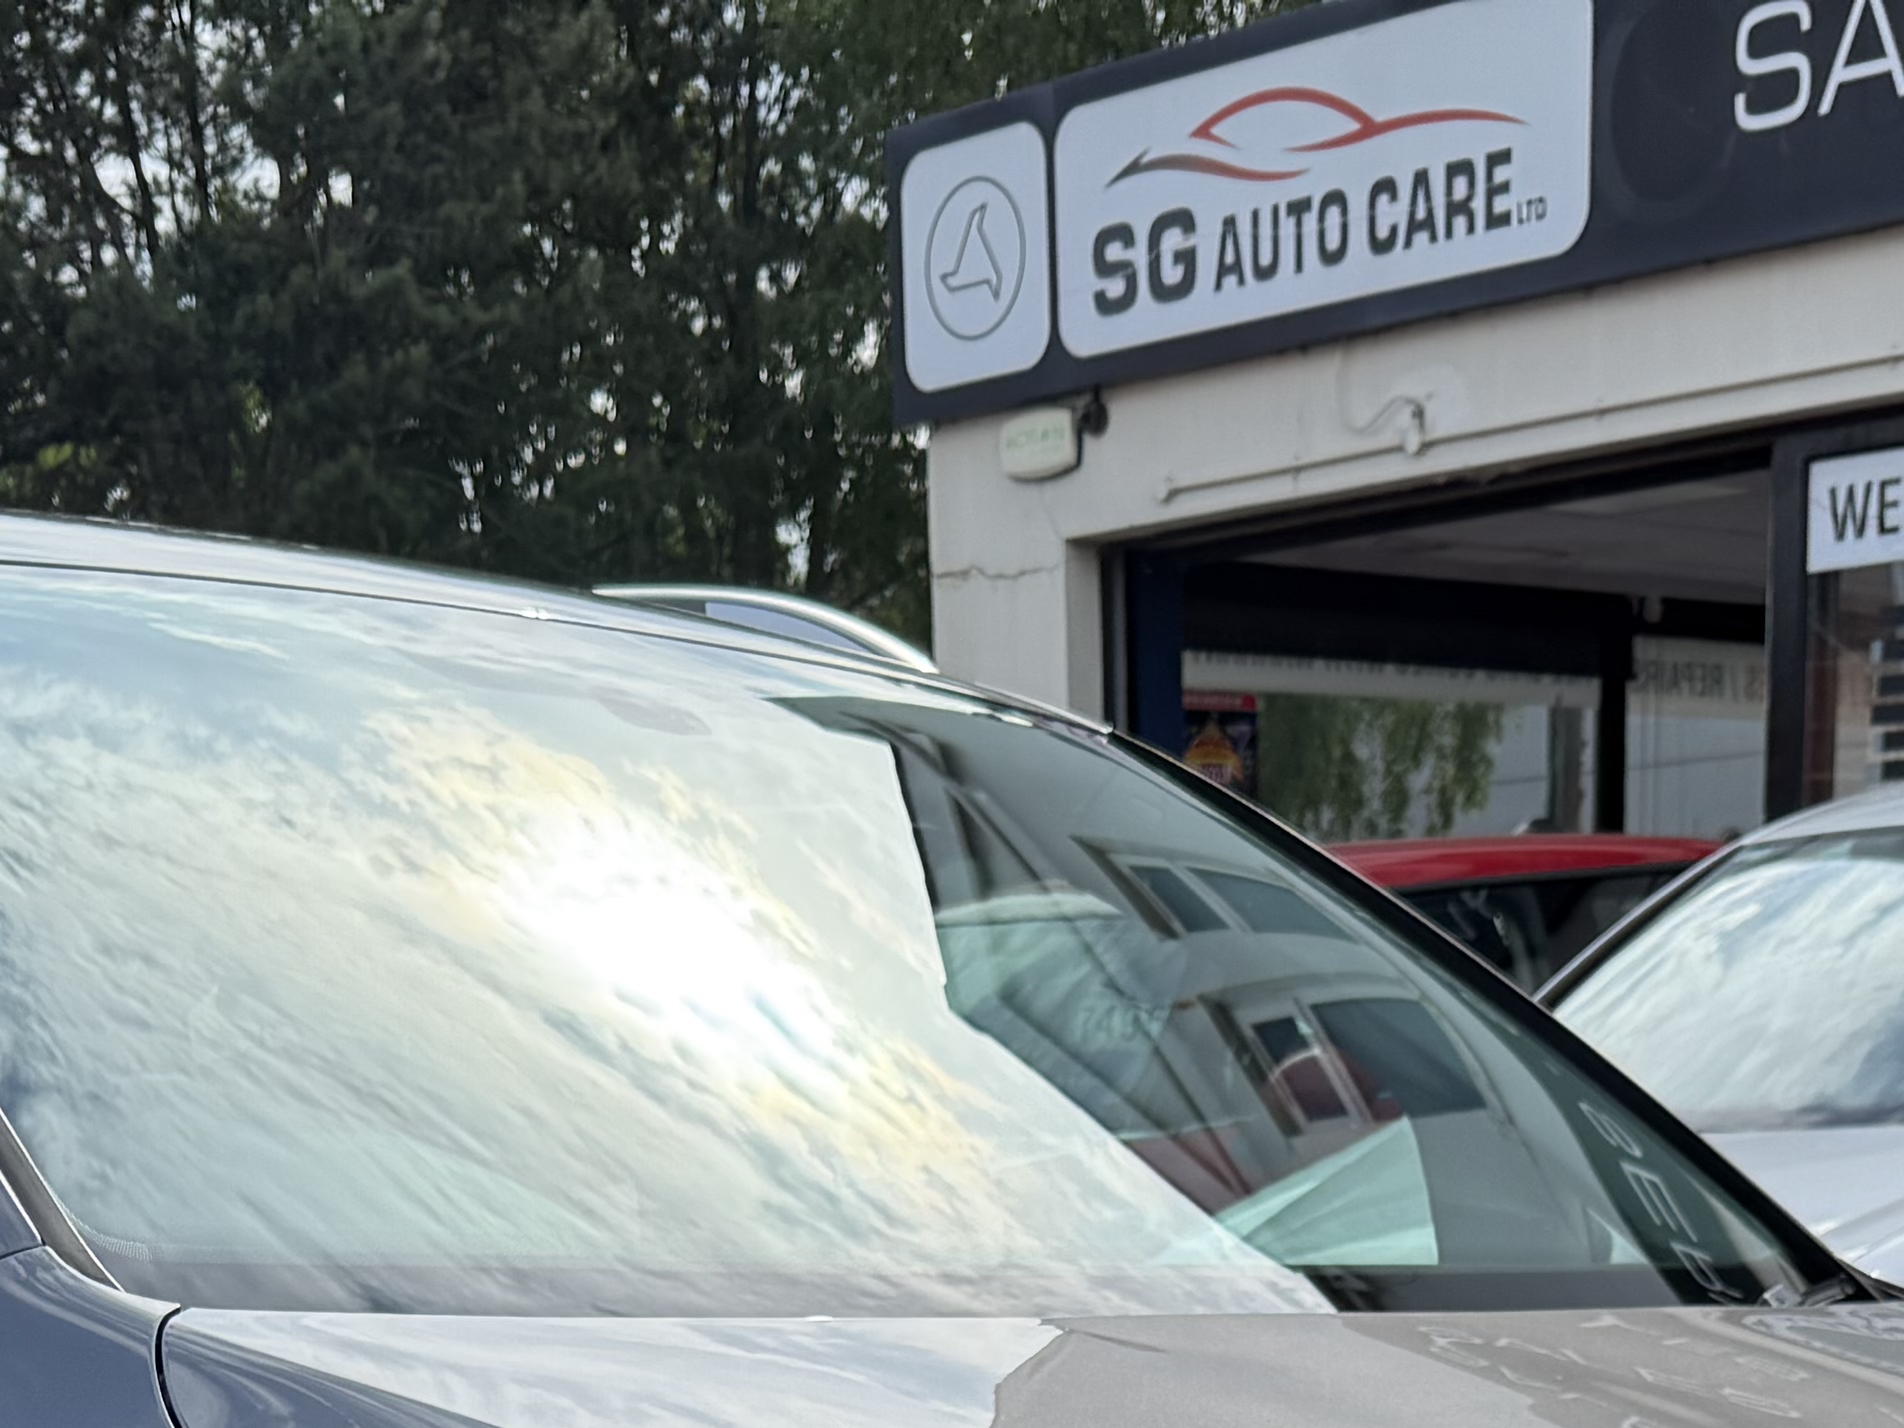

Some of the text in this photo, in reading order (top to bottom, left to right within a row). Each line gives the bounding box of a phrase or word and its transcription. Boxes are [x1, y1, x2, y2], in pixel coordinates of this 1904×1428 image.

[1092, 147, 1548, 317] SG AUTO CARE LTD
[1829, 476, 1903, 542] WE
